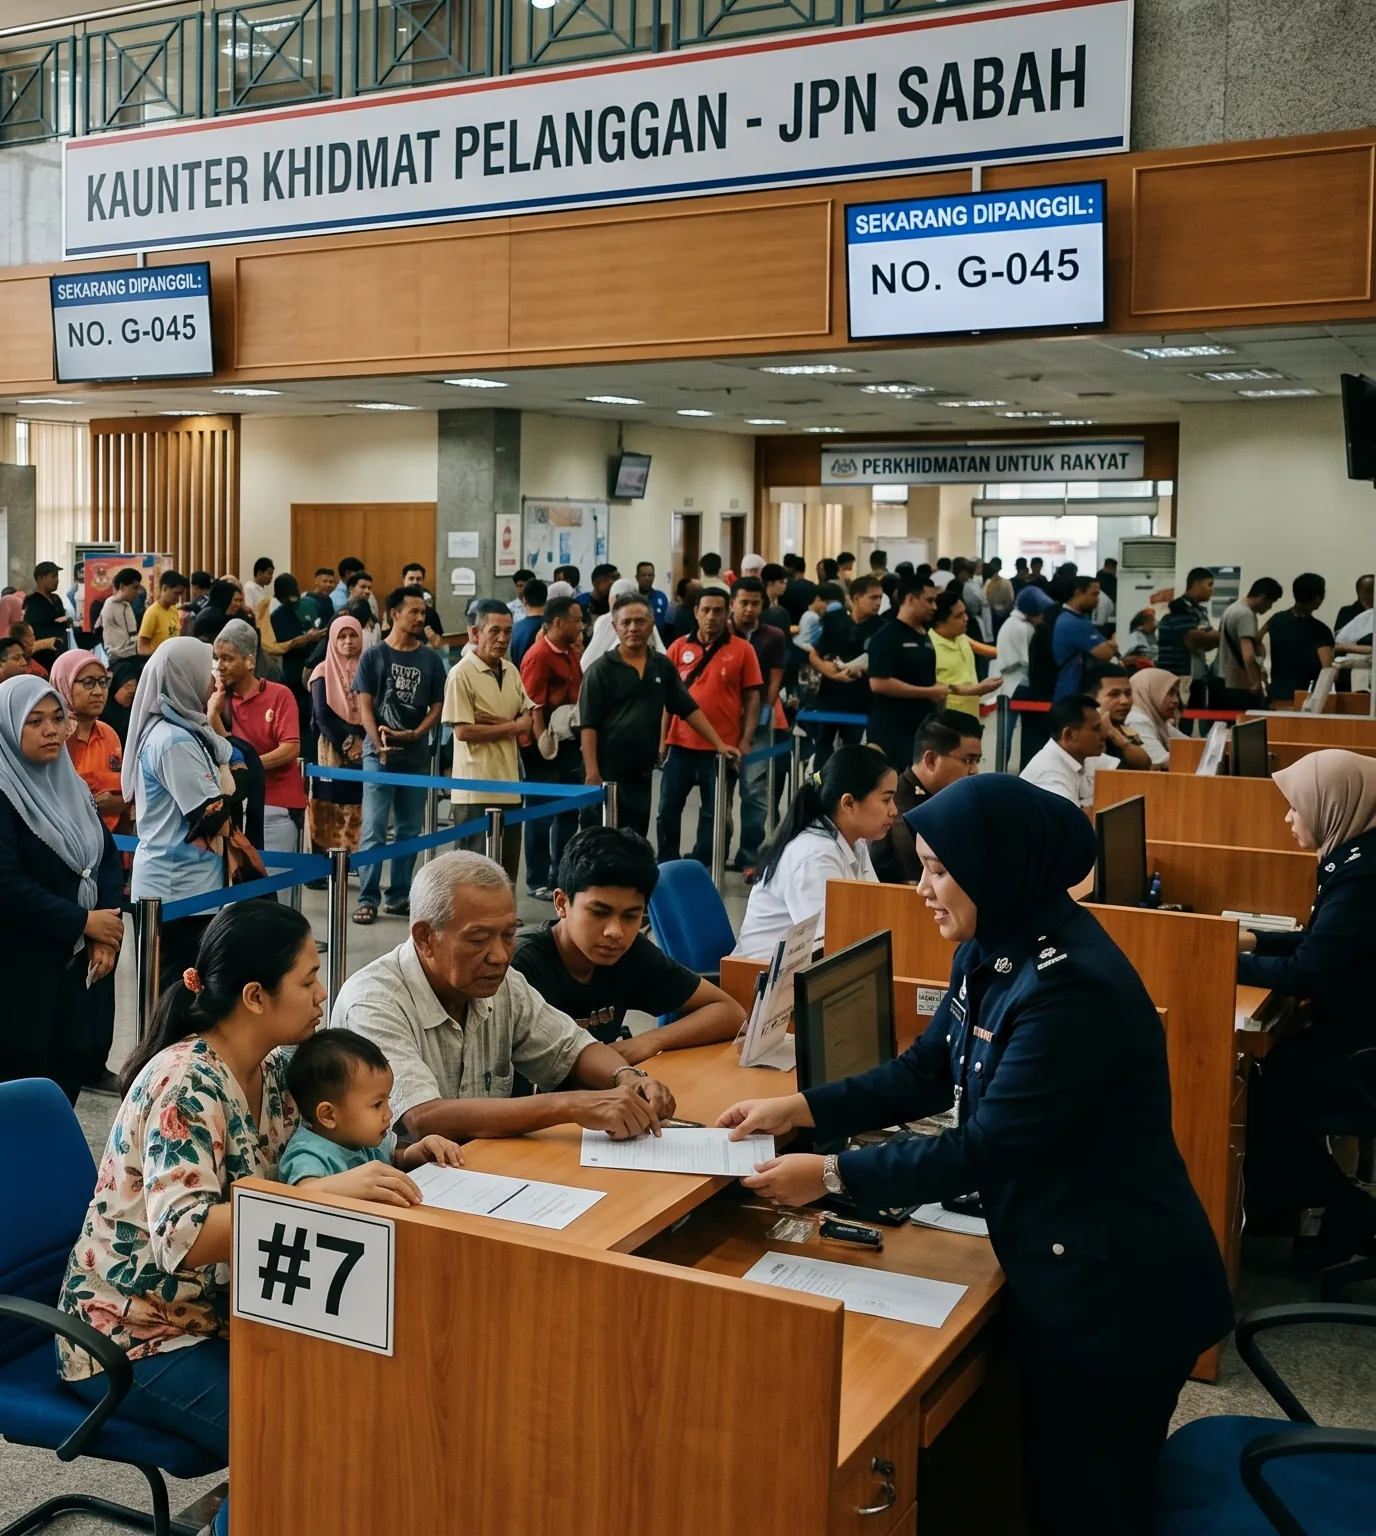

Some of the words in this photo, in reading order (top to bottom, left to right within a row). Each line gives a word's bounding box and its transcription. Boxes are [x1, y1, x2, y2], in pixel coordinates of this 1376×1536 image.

[88, 156, 248, 221] KAUNTER
[264, 130, 440, 201] KHIDMAT
[456, 92, 727, 179] PELANGGAN
[747, 118, 761, 127] -
[779, 73, 876, 142] JPN
[898, 45, 1086, 128] SABAH
[856, 206, 967, 234] SEKARANG
[973, 197, 1094, 224] DIPANGGIL:
[58, 280, 126, 300] SEKARANG
[129, 274, 202, 294] DIPANGGIL:
[872, 261, 940, 294] NO.
[958, 248, 1079, 287] G-045
[68, 320, 112, 347] NO.
[121, 314, 196, 343] G-045
[863, 456, 990, 474] PERKHIDMATAN
[996, 455, 1054, 472] UNTUK
[1061, 452, 1130, 470] RAKYAT
[259, 1223, 364, 1316] #7
